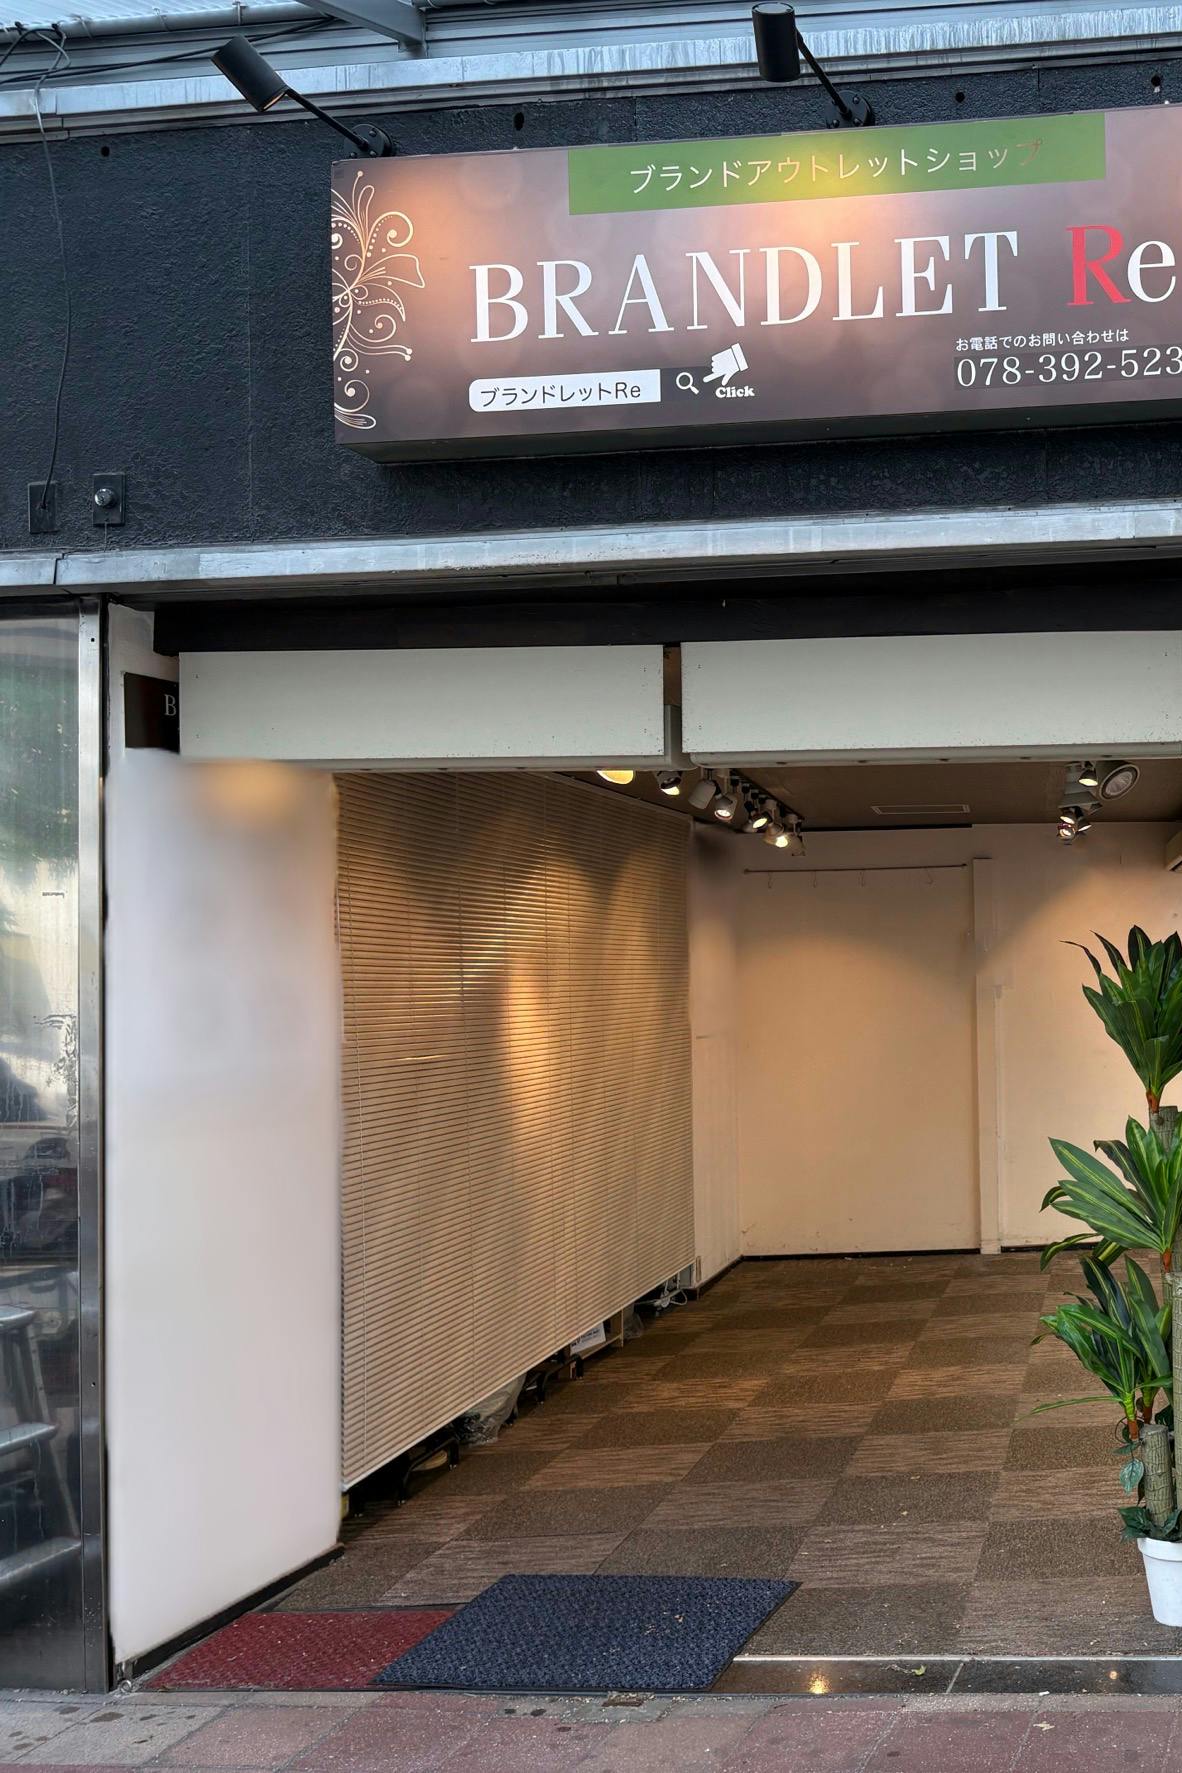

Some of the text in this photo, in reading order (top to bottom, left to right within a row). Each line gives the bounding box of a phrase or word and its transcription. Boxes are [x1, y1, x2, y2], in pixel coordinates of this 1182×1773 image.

[629, 138, 1043, 195] ブランドアウトレットショップ
[468, 230, 1018, 343] BRANDLET
[955, 328, 1130, 352] お電話でのお問い合わせは
[479, 381, 642, 408] ブランドレットRe
[715, 384, 756, 399] Click
